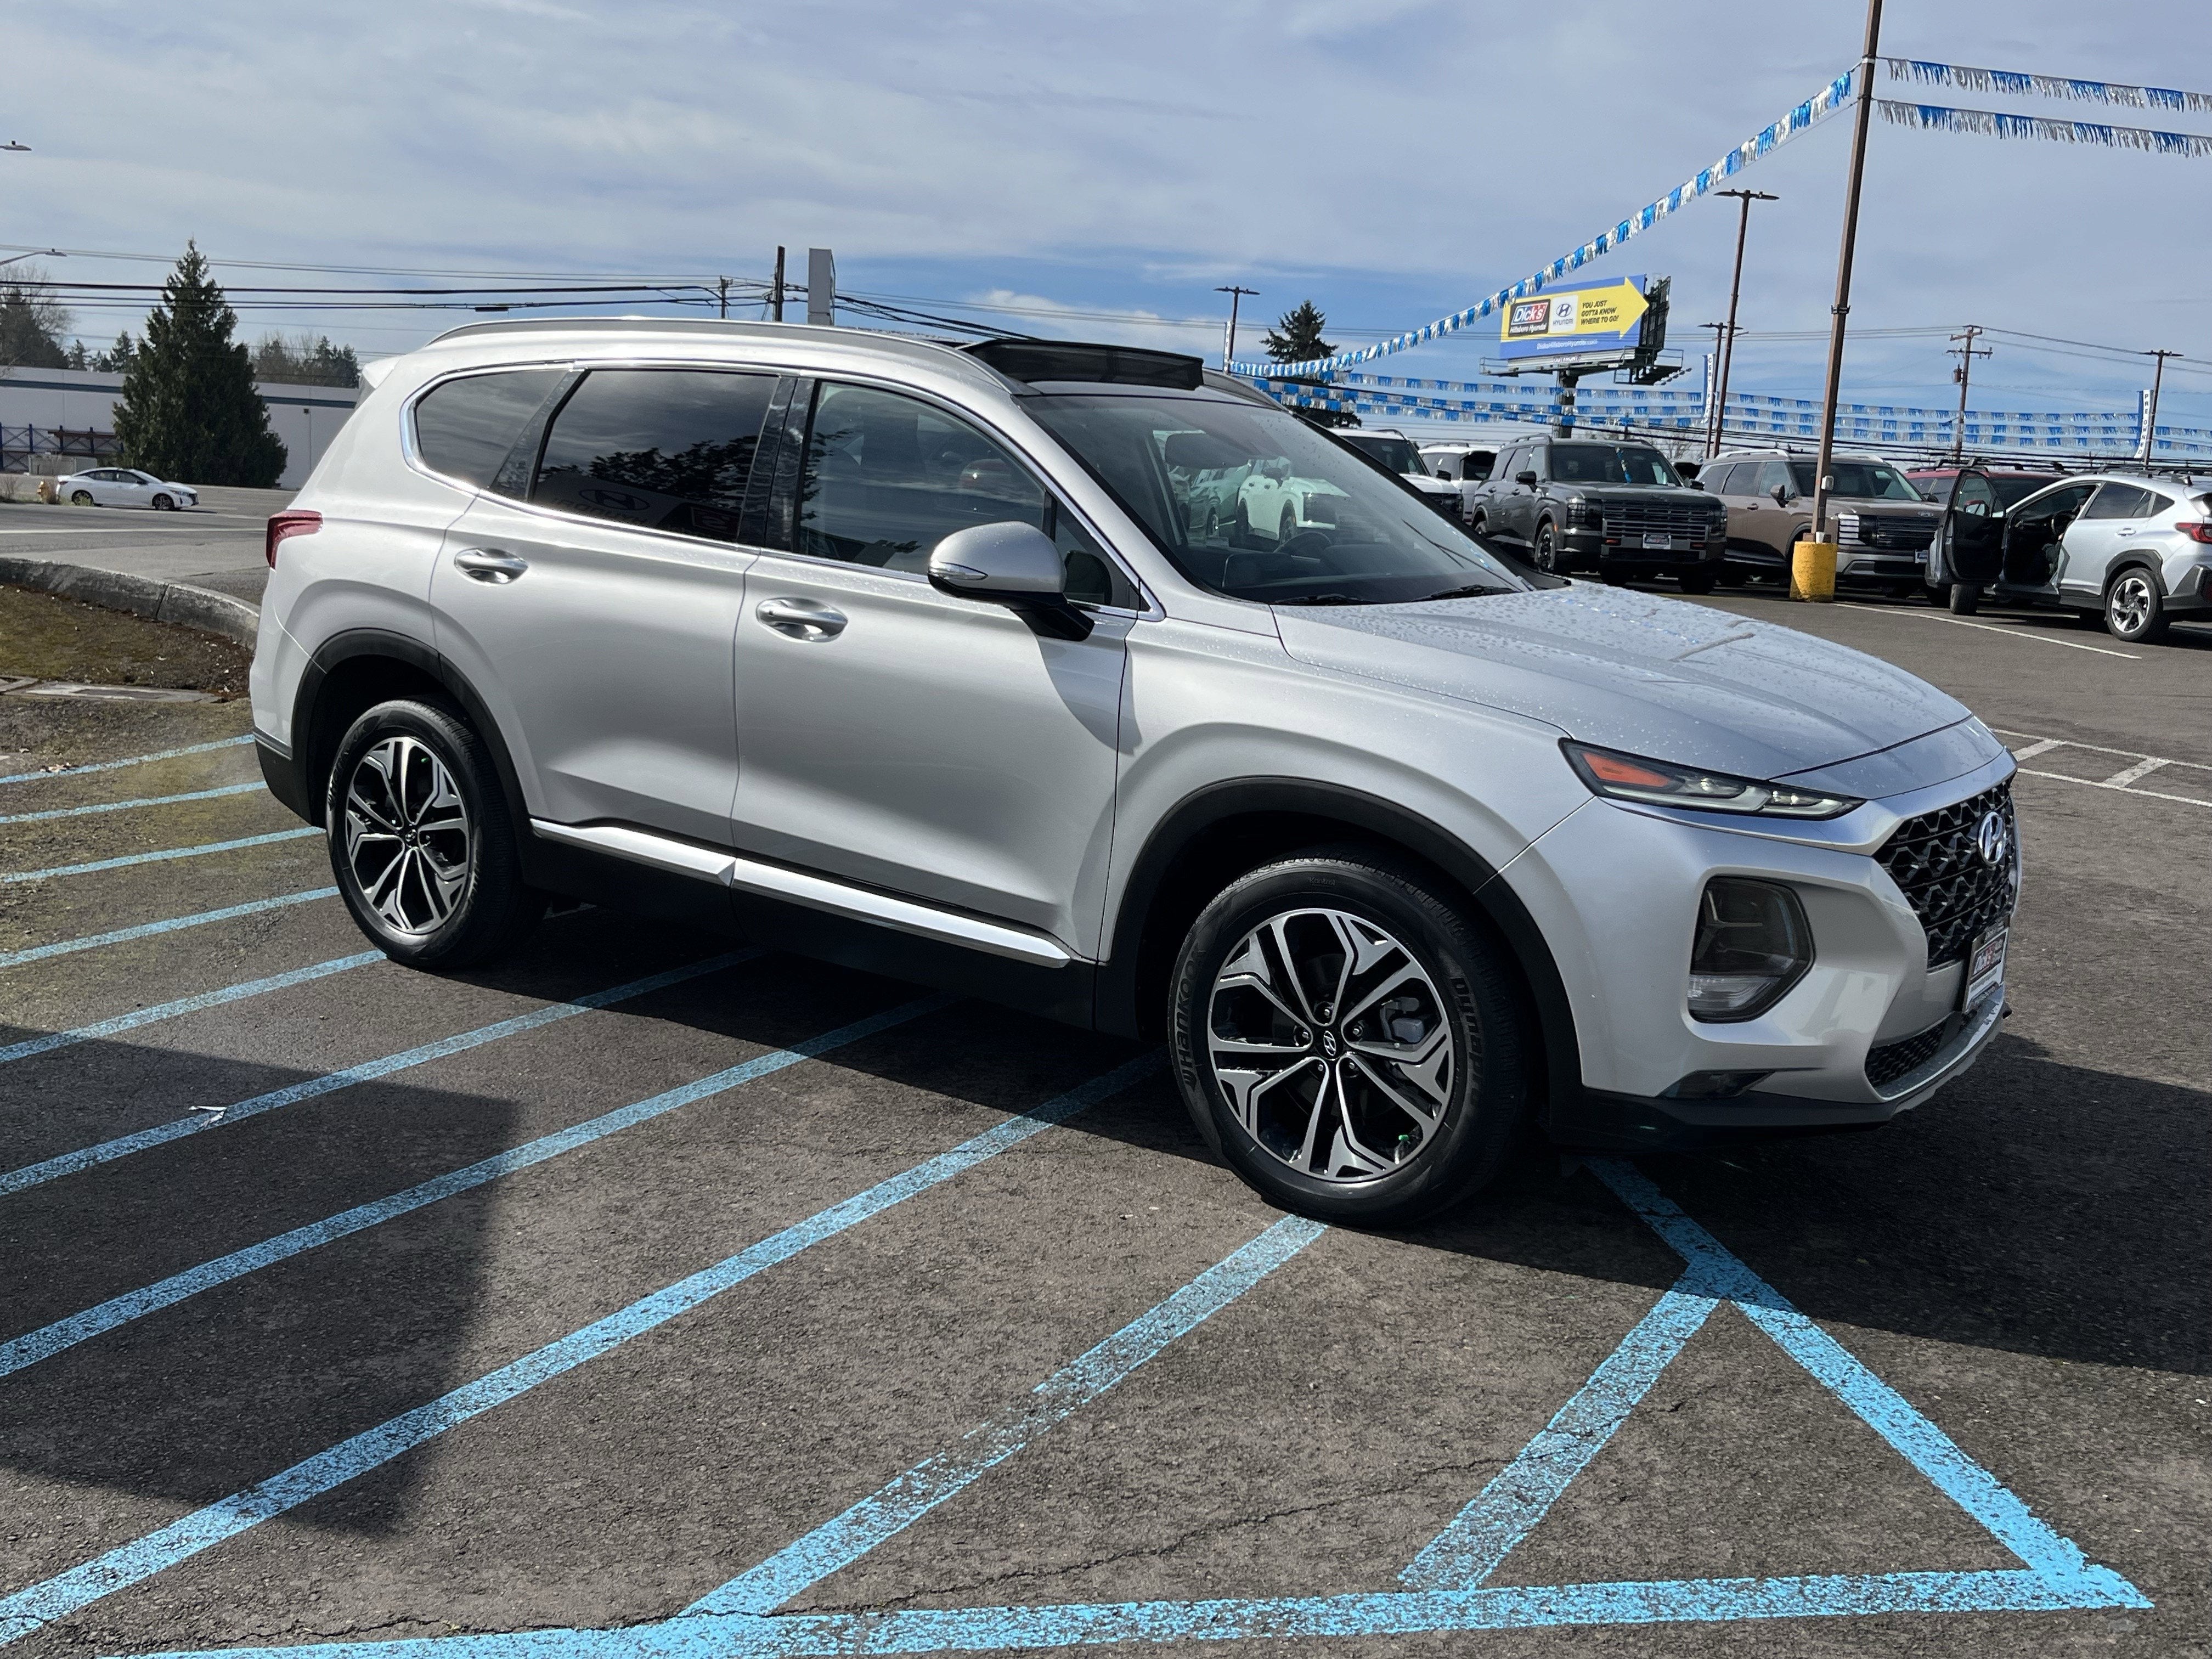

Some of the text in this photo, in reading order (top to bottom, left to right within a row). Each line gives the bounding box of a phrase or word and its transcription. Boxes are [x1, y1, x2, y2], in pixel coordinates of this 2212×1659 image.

[1514, 304, 1545, 323] Dick's
[1599, 307, 1617, 315] KNOW
[1581, 317, 1600, 325] WHERE
[2138, 419, 2147, 454] OWNED
